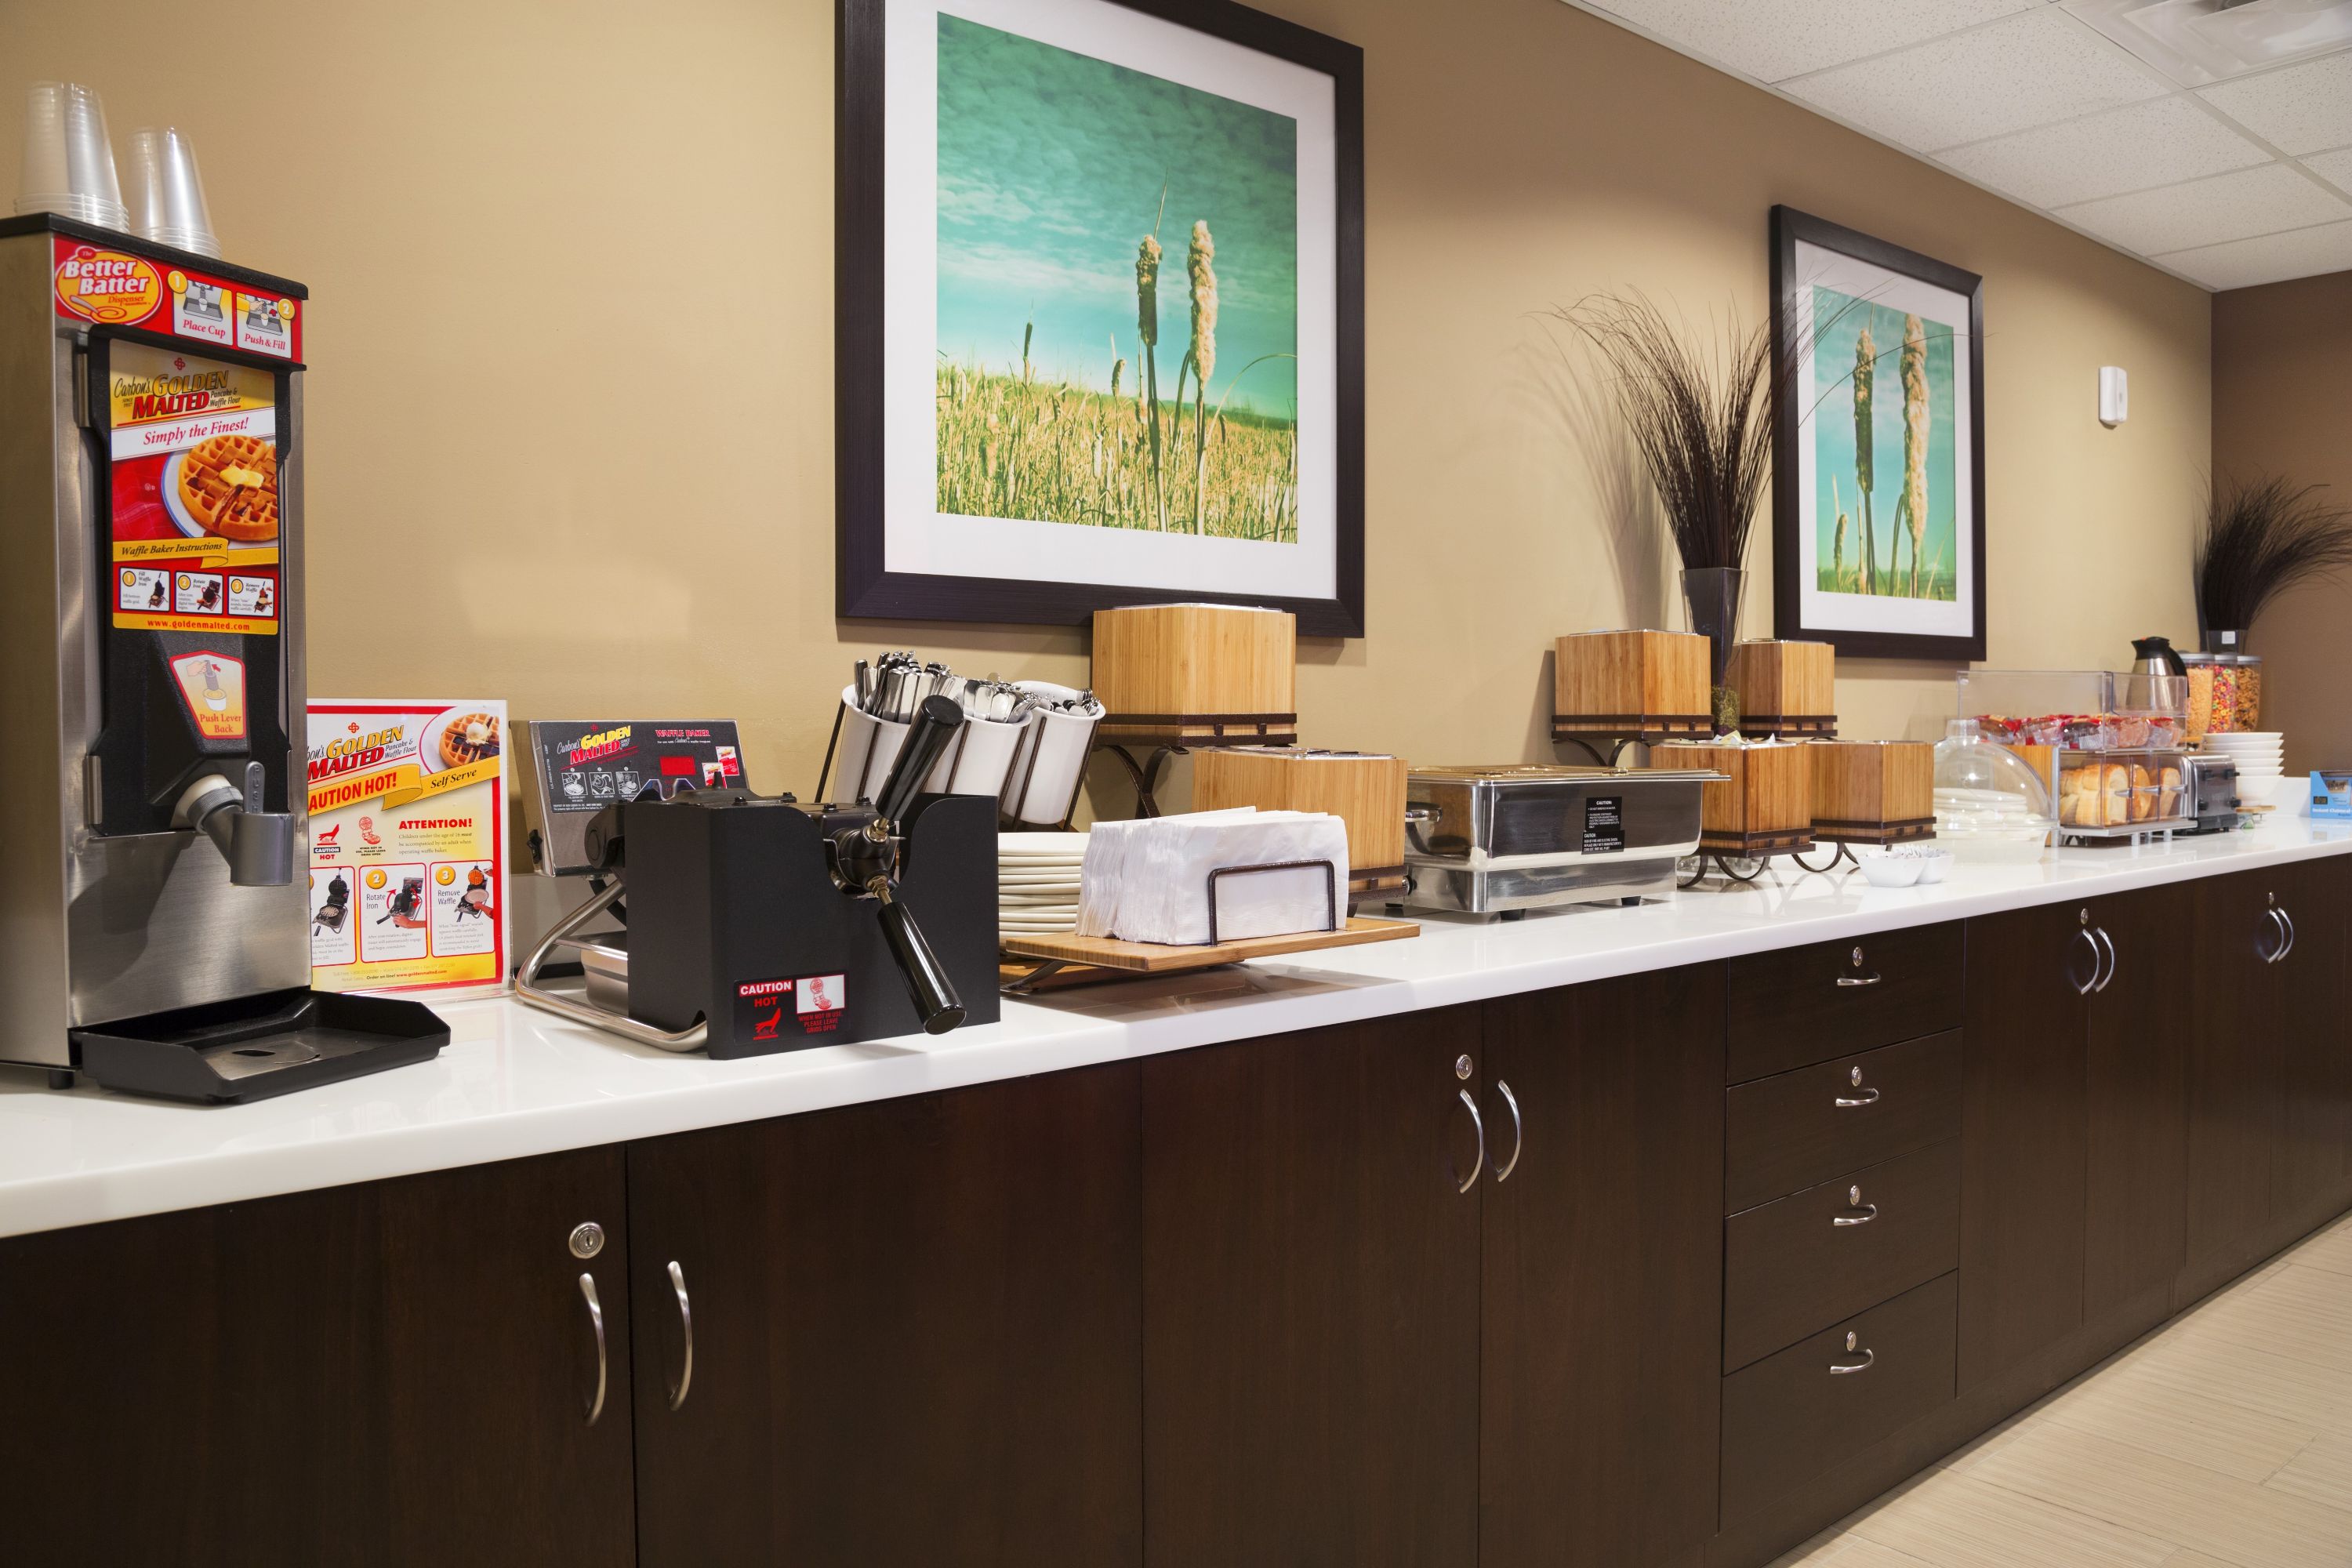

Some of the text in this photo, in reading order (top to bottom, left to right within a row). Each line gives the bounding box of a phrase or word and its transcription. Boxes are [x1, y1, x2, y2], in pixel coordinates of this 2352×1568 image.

[64, 260, 137, 278] Better
[79, 278, 150, 295] Batter
[175, 275, 180, 289] 1
[108, 296, 145, 307] Dispenser
[283, 303, 289, 314] 2
[183, 319, 226, 339] Place Cup
[245, 333, 264, 346] Push
[273, 339, 285, 350] Fill
[114, 370, 229, 398] Carbon's GOLDEN
[210, 388, 232, 398] Pancake
[132, 392, 210, 419] MALTED
[209, 397, 227, 408] Waffle
[143, 417, 249, 445] Simply the Finest!
[122, 542, 223, 557] Waffle Baker Instructions
[147, 619, 249, 630] www.goldenmalted.com
[200, 713, 241, 722] Push Lever
[214, 724, 234, 733] Back
[307, 725, 405, 761] bon's GOLDEN
[581, 725, 631, 750] GOLDEN
[385, 746, 417, 759] Waffle Flour
[386, 741, 408, 752] Pancake
[570, 740, 621, 765] MALTED
[307, 746, 385, 782] MALTED
[430, 769, 477, 789] Self Serve
[308, 771, 397, 811] AUTION HOT!
[399, 818, 472, 829] ATTENTION!
[372, 873, 380, 884] 2
[441, 870, 449, 880] 3
[366, 893, 386, 902] Rotate
[437, 889, 460, 898] Remove
[437, 897, 456, 905] Waffle
[740, 982, 792, 995] CAUTION
[754, 996, 778, 1007] HOT
